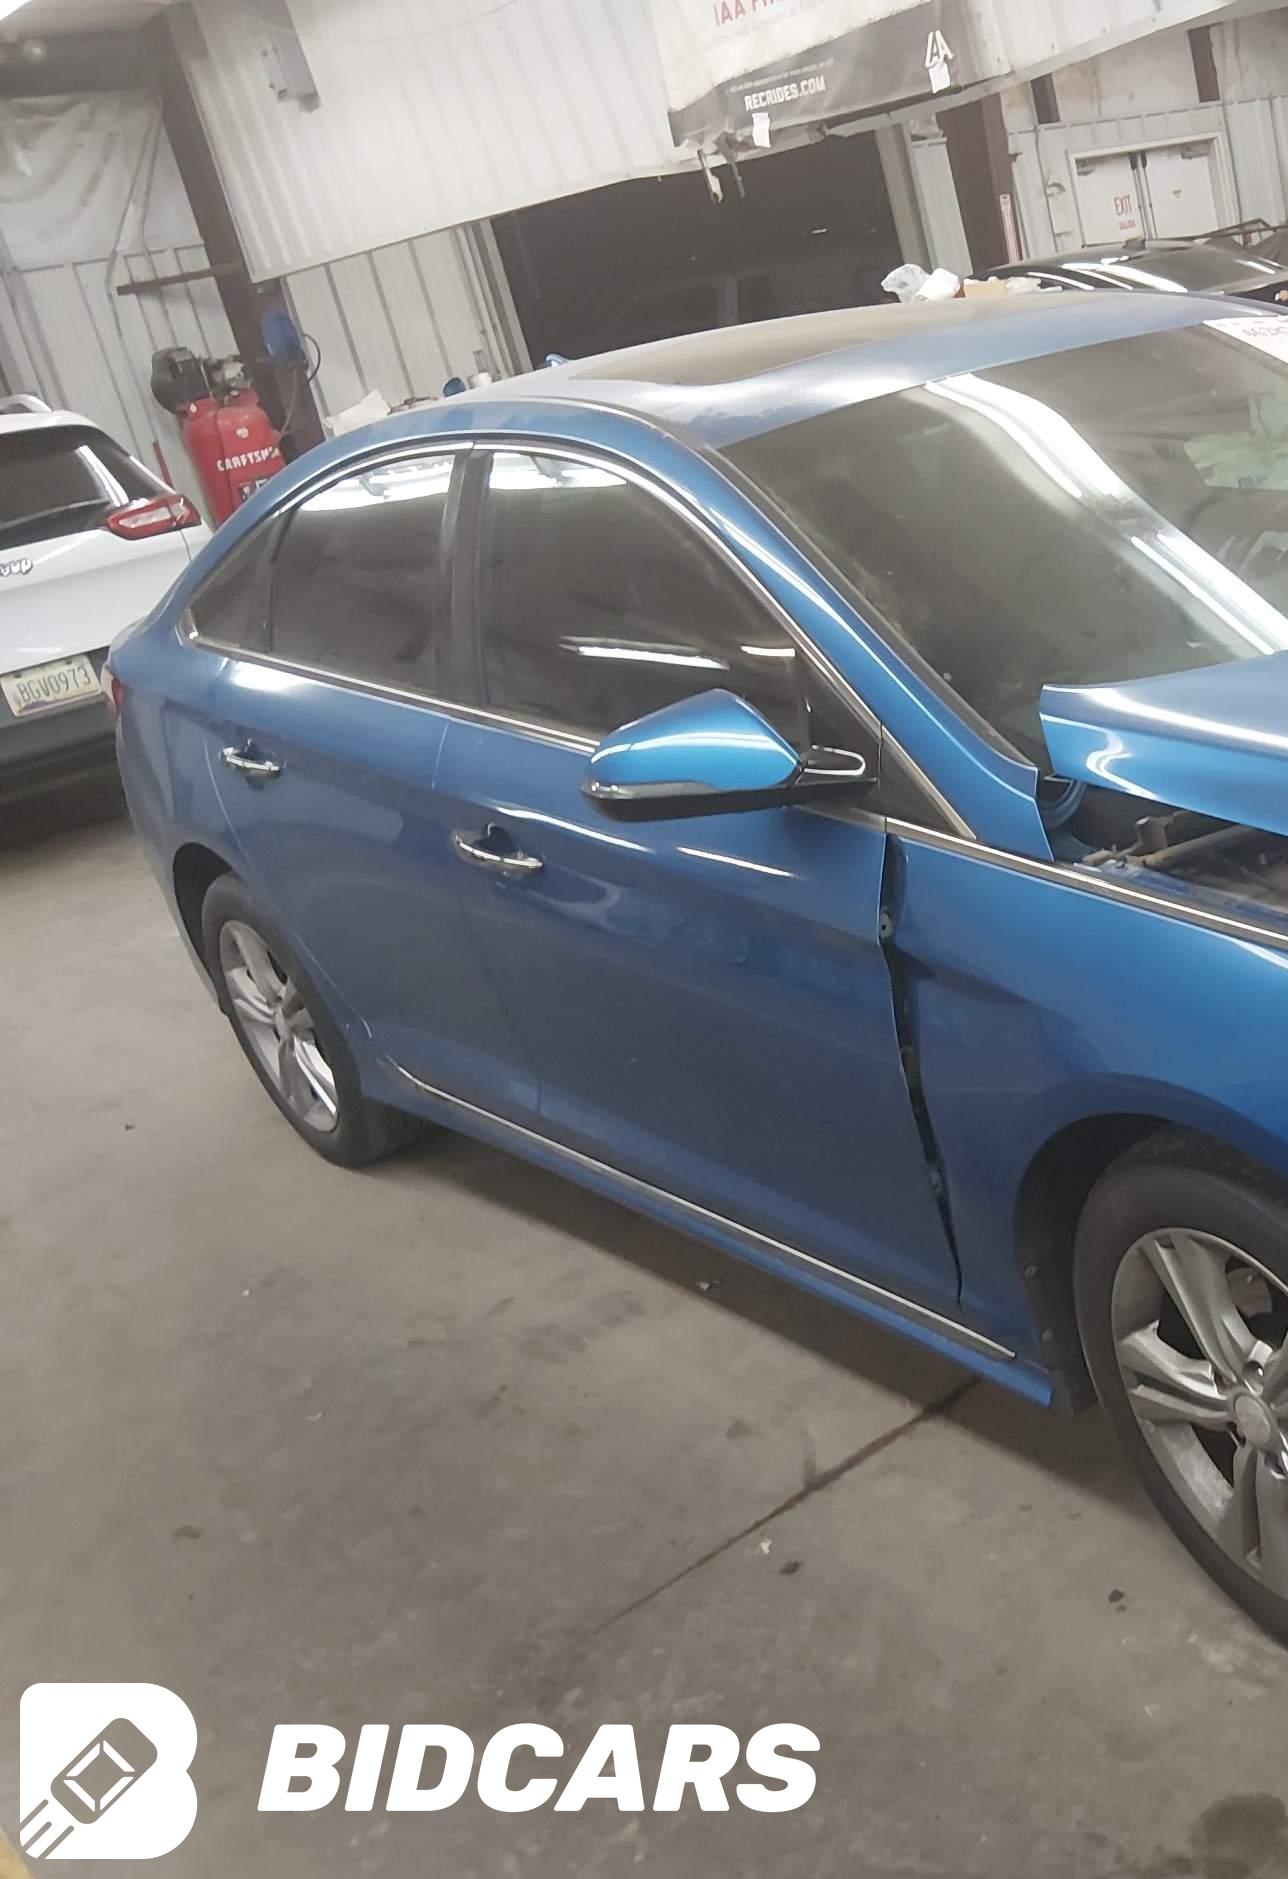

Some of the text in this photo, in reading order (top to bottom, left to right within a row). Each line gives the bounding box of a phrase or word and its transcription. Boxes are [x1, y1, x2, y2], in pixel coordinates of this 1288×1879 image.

[713, 0, 746, 26] IAA
[744, 75, 826, 111] RECRIDES.COM
[1113, 194, 1133, 216] EXIT
